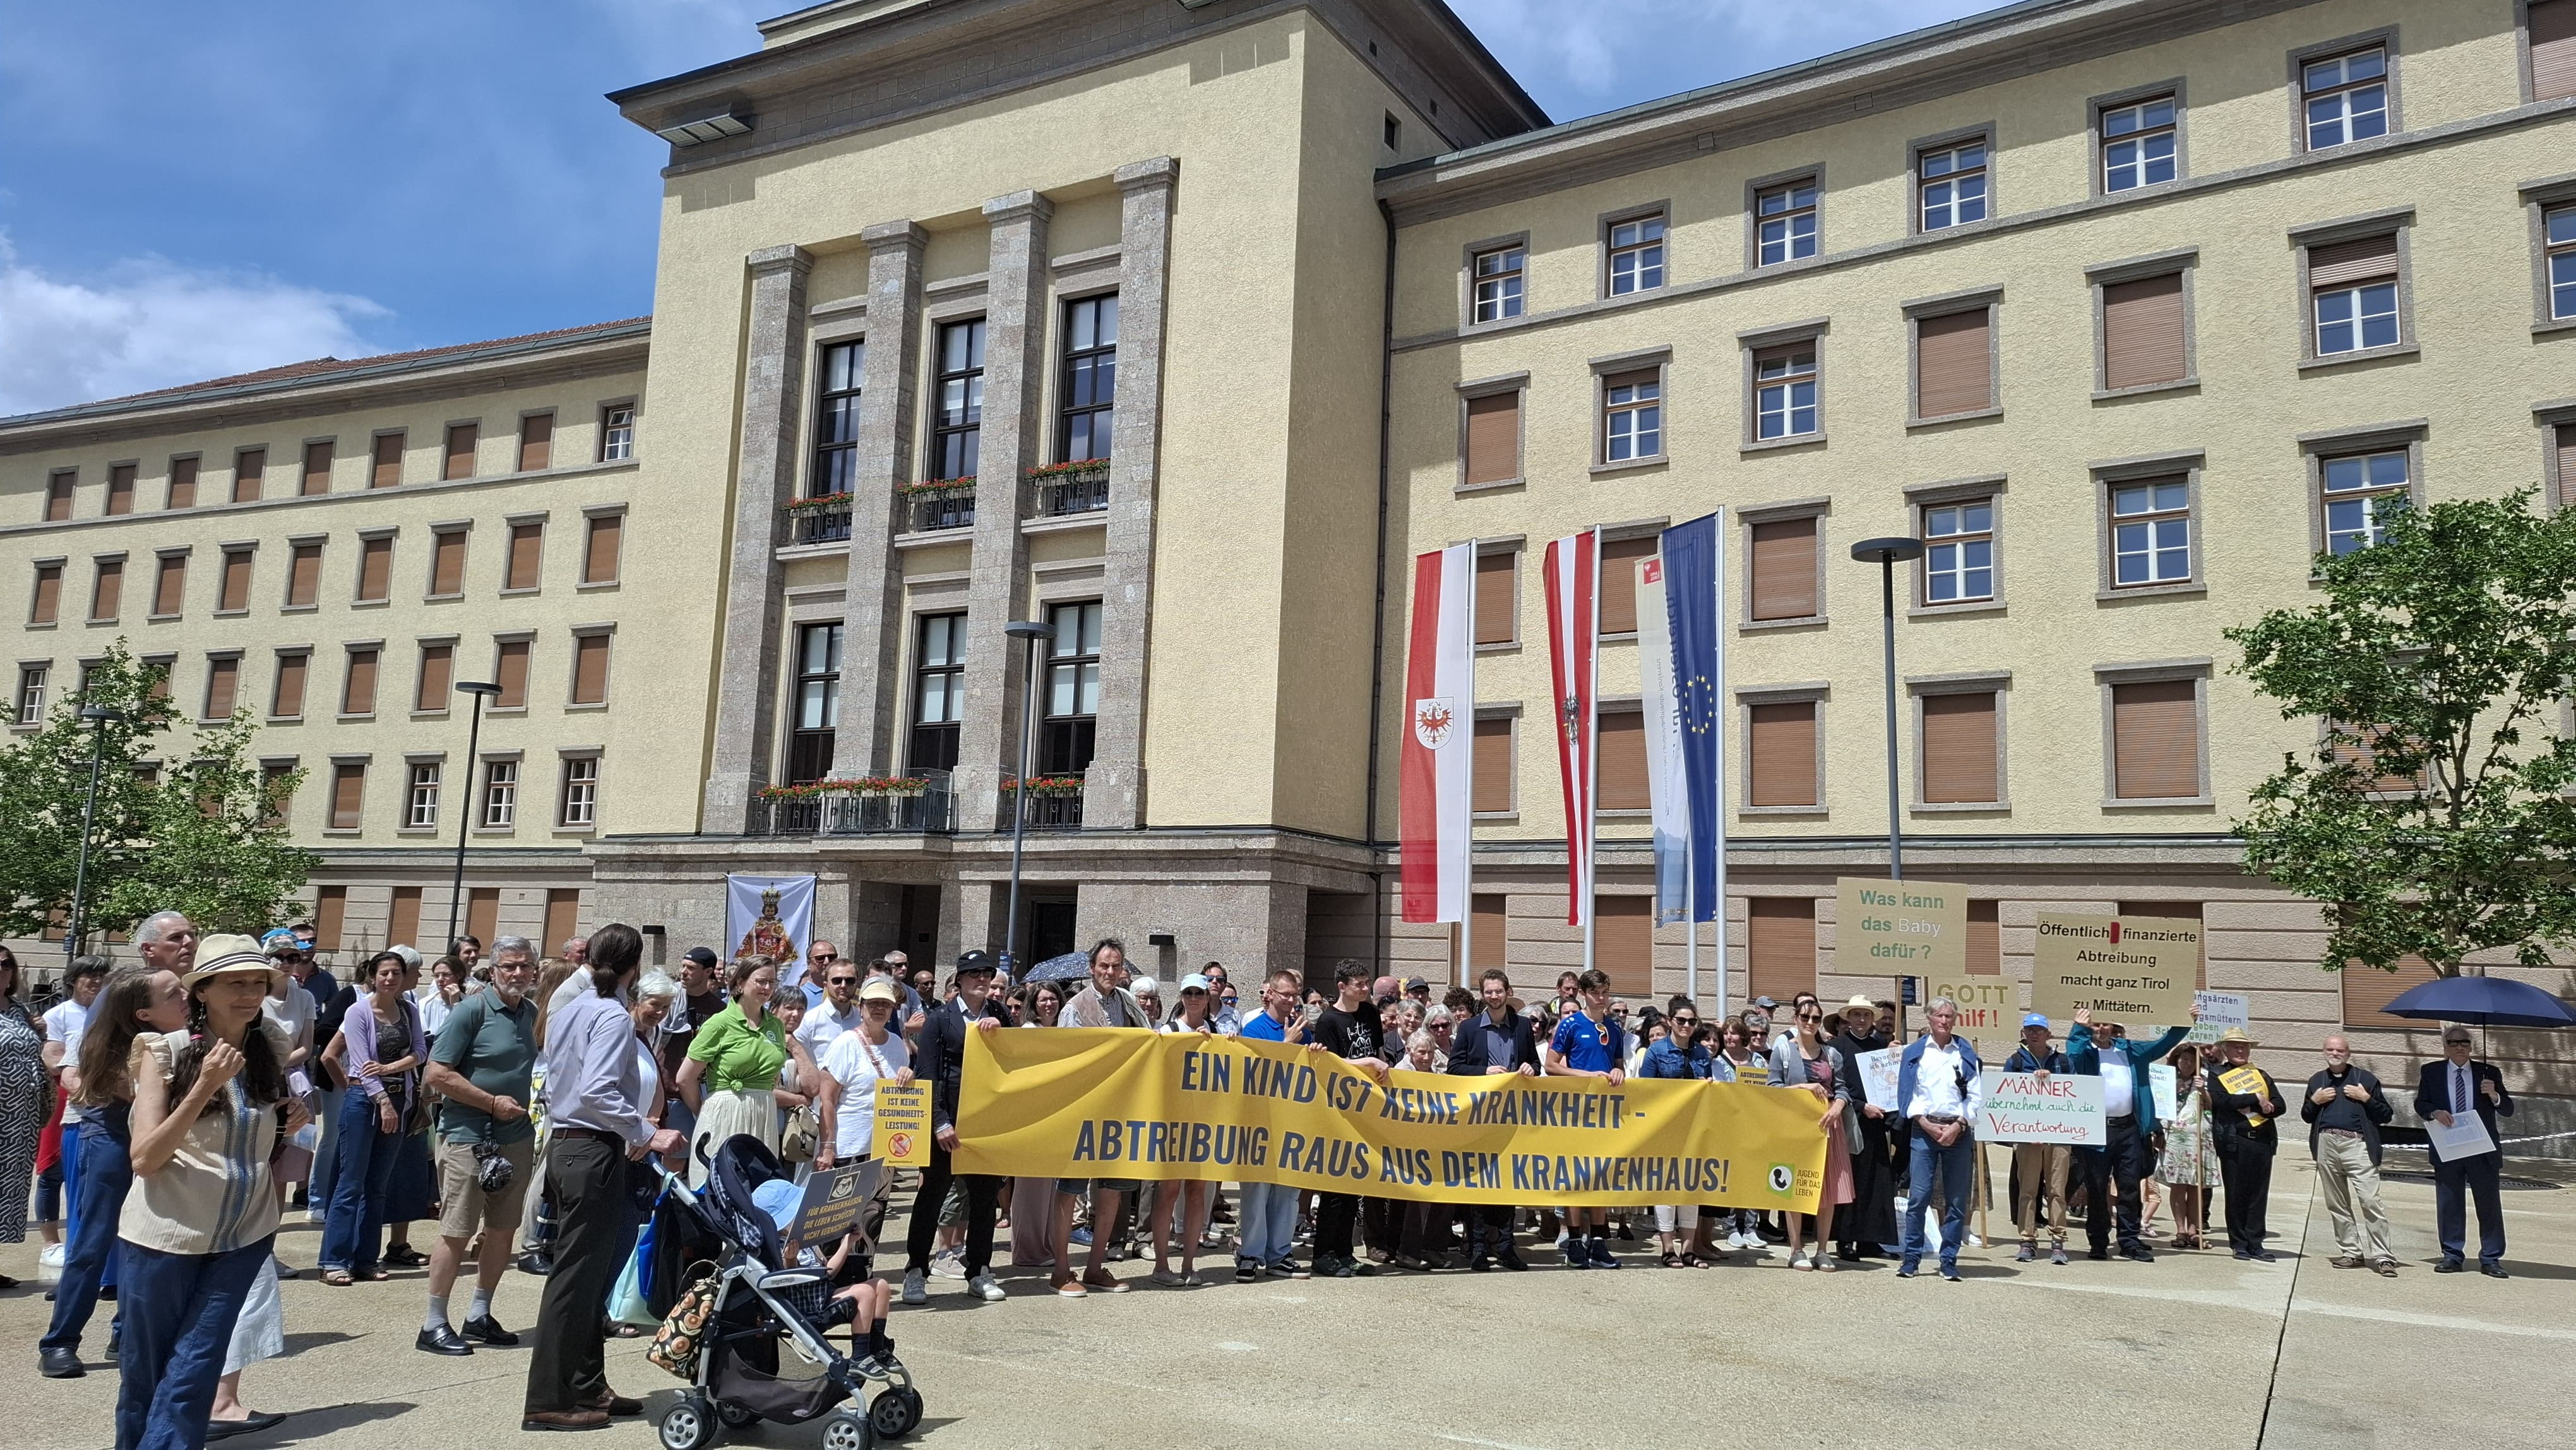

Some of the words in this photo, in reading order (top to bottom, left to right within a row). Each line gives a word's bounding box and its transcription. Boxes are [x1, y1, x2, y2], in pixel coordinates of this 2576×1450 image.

[1859, 889, 1897, 906] Was
[1902, 892, 1944, 909] kann
[1861, 916, 1892, 932] das
[1899, 918, 1941, 938] Baby
[2039, 921, 2109, 938] Öffentlich
[2123, 928, 2197, 942] finanzierte
[1870, 942, 1916, 958] dafür
[2076, 950, 2157, 968] Abtreibung
[2061, 974, 2103, 986] macht
[2106, 978, 2138, 990] ganz
[2141, 977, 2169, 990] Tirol
[1938, 983, 2008, 1004] GOTT
[2073, 1000, 2089, 1009] zu
[2093, 999, 2154, 1014] Mittätern.
[881, 1086, 924, 1096] ABTREIBUNG
[1181, 1050, 1230, 1093] EIN
[1243, 1056, 1316, 1103] KIND
[1327, 1071, 1373, 1112] IST
[1380, 1086, 1460, 1125] KEINE
[1467, 1089, 1626, 1129] KRANKHEIT
[1996, 1076, 2077, 1098] MÄNNER
[888, 1098, 898, 1106] IST
[900, 1098, 919, 1106] KEINE
[1982, 1097, 2044, 1111] übernehmt
[2046, 1100, 2076, 1112] auch
[2078, 1103, 2096, 1112] die
[878, 1109, 927, 1118] GESUNDHEITS-
[885, 1121, 919, 1130] LEISTUNG!
[1988, 1113, 2089, 1141] Verantwortung
[1073, 1120, 1269, 1166] ABTREIBUNG
[1279, 1130, 1369, 1180] RAUS
[1379, 1146, 1433, 1187] AUS
[1441, 1150, 1501, 1189] DEM
[1512, 1153, 1729, 1193] KRANKENHAUS!
[1797, 1170, 1819, 1178] JUGEND
[1796, 1178, 1808, 1187] FÜR
[1810, 1180, 1820, 1189] DAS
[1795, 1189, 1813, 1197] LEBEN
